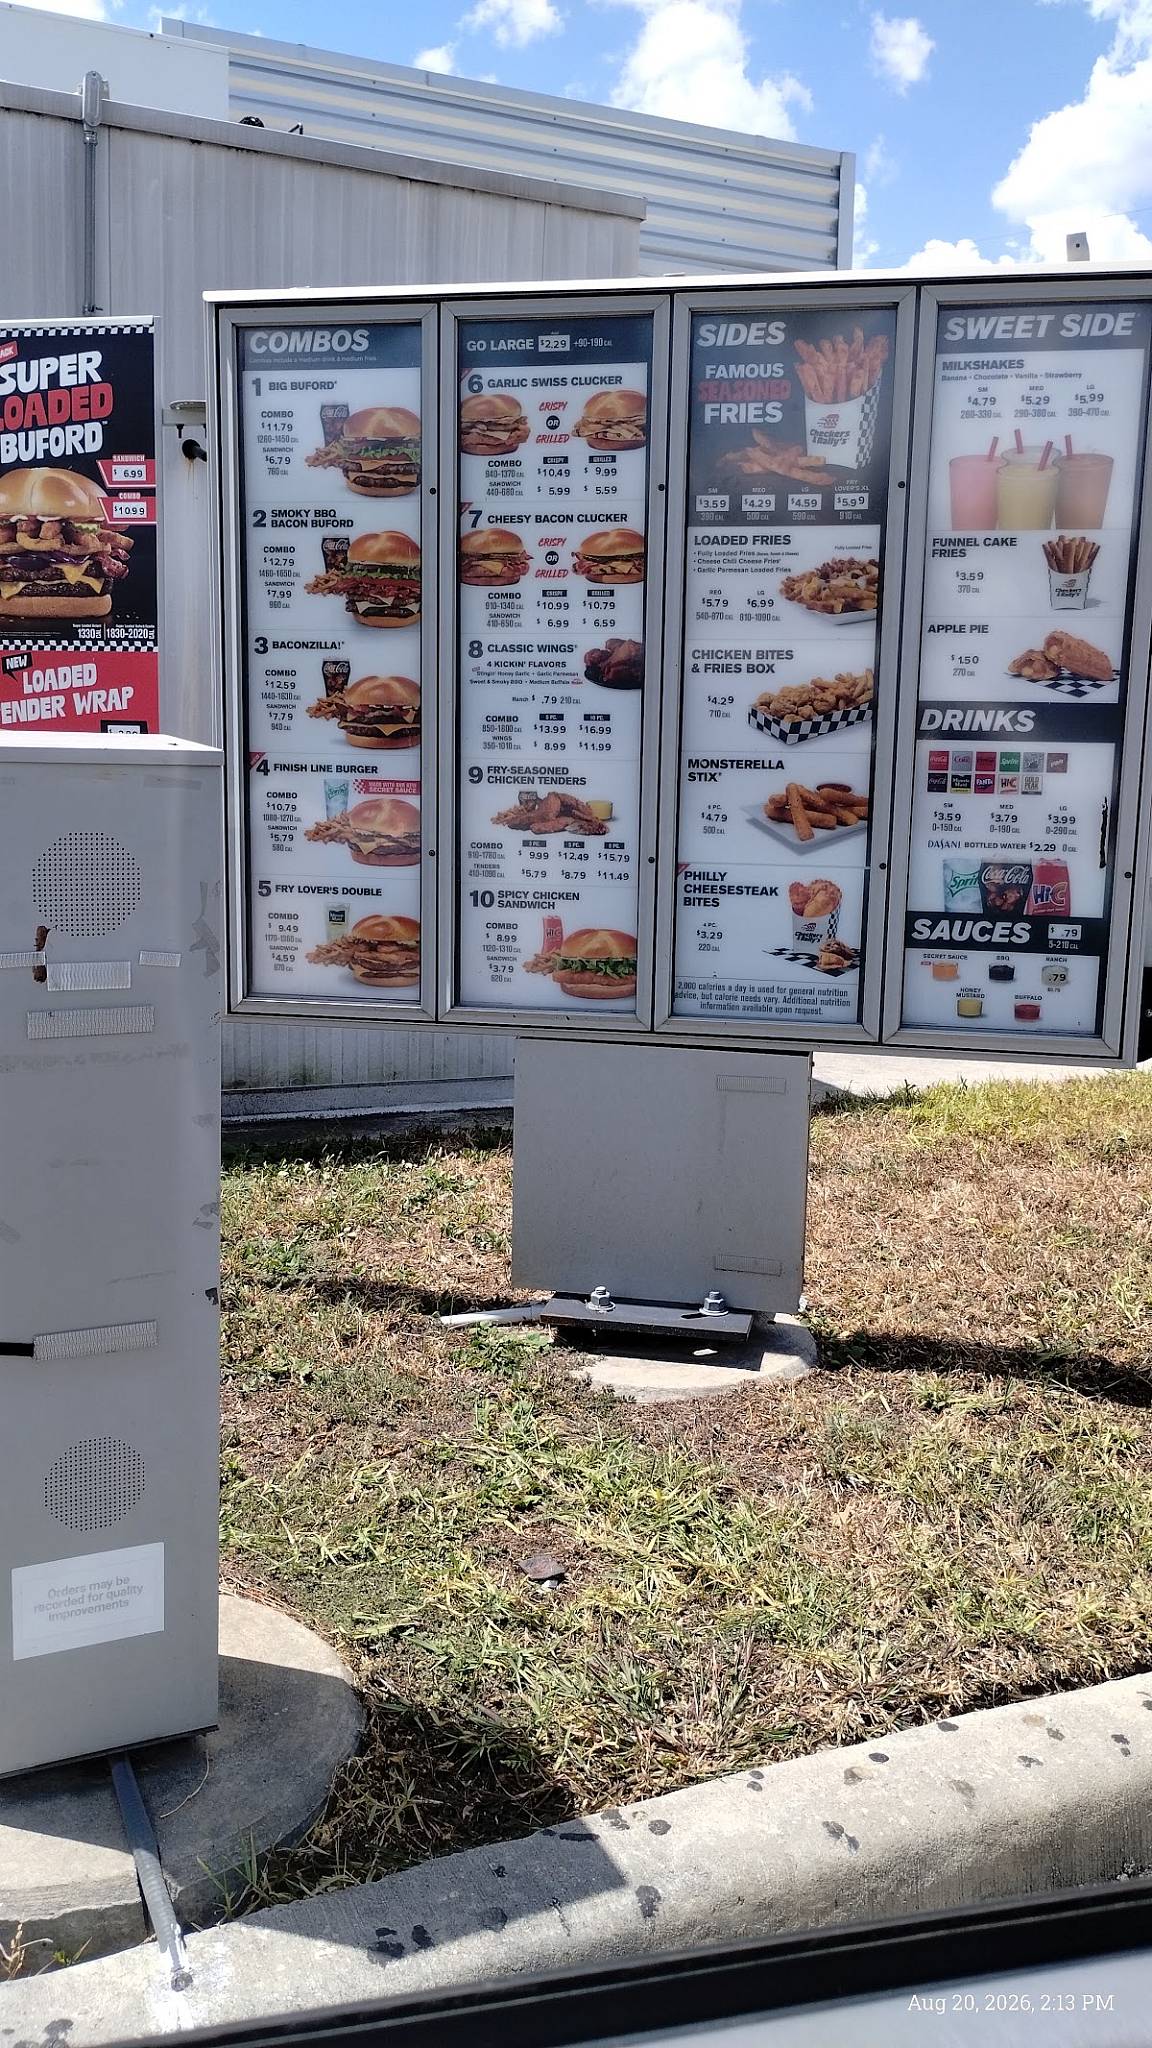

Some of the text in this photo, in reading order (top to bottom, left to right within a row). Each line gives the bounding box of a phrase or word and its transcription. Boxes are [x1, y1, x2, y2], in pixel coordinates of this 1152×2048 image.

[944, 315, 1056, 341] SWEET
[697, 321, 786, 347] SIDES
[250, 330, 370, 353] COMBOS
[467, 340, 486, 351] GO
[491, 339, 534, 350] LARGE
[540, 340, 567, 348] $2.29
[942, 360, 1024, 371] MILKSHAKES
[0, 351, 102, 395] SUPER
[705, 363, 784, 379] FAMOUS
[252, 378, 261, 396] 1
[269, 382, 287, 390] BIG
[468, 374, 622, 393] 6 GARLIC SWISS CLUCKER
[698, 380, 791, 401] SEASONED
[968, 396, 996, 407] $4.79
[1021, 395, 1050, 405] $5.29
[539, 401, 568, 411] CRISPY
[704, 402, 783, 424] FRIES
[261, 422, 293, 432] $11.79
[548, 419, 559, 427] OR
[536, 434, 570, 443] GRILLED
[810, 429, 850, 438] Checkers
[265, 455, 291, 464] $6.79
[538, 468, 571, 477] $10.49
[744, 498, 772, 508] $4.29
[252, 509, 337, 528] 2 SMOKY BBQ
[271, 519, 353, 528] BACON BUFORD
[468, 510, 628, 528] 7 CHEESY BACON CLUCKER
[694, 534, 792, 546] LOADED FRIES
[933, 537, 1017, 547] FUNNEL CAKE
[932, 549, 967, 558] FRIES
[264, 557, 295, 567] $12.79
[956, 571, 984, 581] $3.59
[268, 589, 292, 598] $7.99
[537, 601, 569, 610] $10.99
[583, 600, 616, 610] $10.79
[702, 598, 729, 607] $5.79
[748, 598, 774, 608] $6.99
[78, 629, 95, 638] 1330
[107, 629, 148, 639] 1830-2020
[928, 625, 989, 634] APPLE PIE
[254, 637, 268, 654] 3
[468, 640, 483, 658] 8
[488, 644, 533, 653] CLASSIC
[691, 650, 794, 660] CHICKEN BITES
[6, 655, 27, 670] NEW
[691, 663, 775, 673] & FRIES BOX
[23, 663, 97, 694] LOADED
[73, 687, 133, 715] WRAP
[708, 695, 734, 705] $4.29
[920, 709, 1036, 732] DRINKS
[534, 724, 567, 733] $13.99
[579, 742, 612, 751] $11.99
[256, 759, 378, 776] 4 FINISH LINE BURGER
[687, 759, 785, 770] MONSTERELLA
[468, 766, 569, 784] 9 FRY-SEASONED
[488, 776, 587, 786] CHICKEN TENDERS
[267, 802, 297, 812] $10.79
[701, 812, 728, 822] $4.79
[934, 811, 961, 821] $3.59
[991, 813, 1018, 823] $3.79
[1048, 814, 1076, 824] $3.99
[270, 833, 294, 842] $5.79
[928, 840, 1056, 852] DASANI BOTTLED WATER $2.29
[558, 852, 589, 861] $12.49
[598, 852, 630, 862] $15.79
[522, 868, 547, 878] $5.79
[598, 870, 629, 881] $11.49
[684, 871, 727, 882] PHILLY
[258, 881, 382, 897] 5 FRY LOVER'S DOUBLE
[683, 884, 779, 896] CHEESESTEAK
[469, 890, 580, 908] 10 SPICY CHICKEN
[683, 897, 720, 907] BITES
[498, 900, 555, 909] SANDWICH
[697, 929, 723, 940] $3.29
[911, 918, 1032, 944] SAUCES
[489, 964, 514, 972] $3.79
[699, 983, 725, 991] calories
[735, 984, 747, 993] day
[758, 985, 774, 993] used
[789, 987, 815, 996] general
[818, 987, 848, 996] nutrition
[715, 993, 738, 1001] calorie
[783, 996, 818, 1005] Additional
[821, 998, 850, 1006] nutrition
[700, 1003, 739, 1011] information
[742, 1004, 772, 1012] available
[48, 1576, 130, 1599] Orders may be
[34, 1585, 144, 1613] recorded for quality
[48, 1599, 129, 1621] improvements
